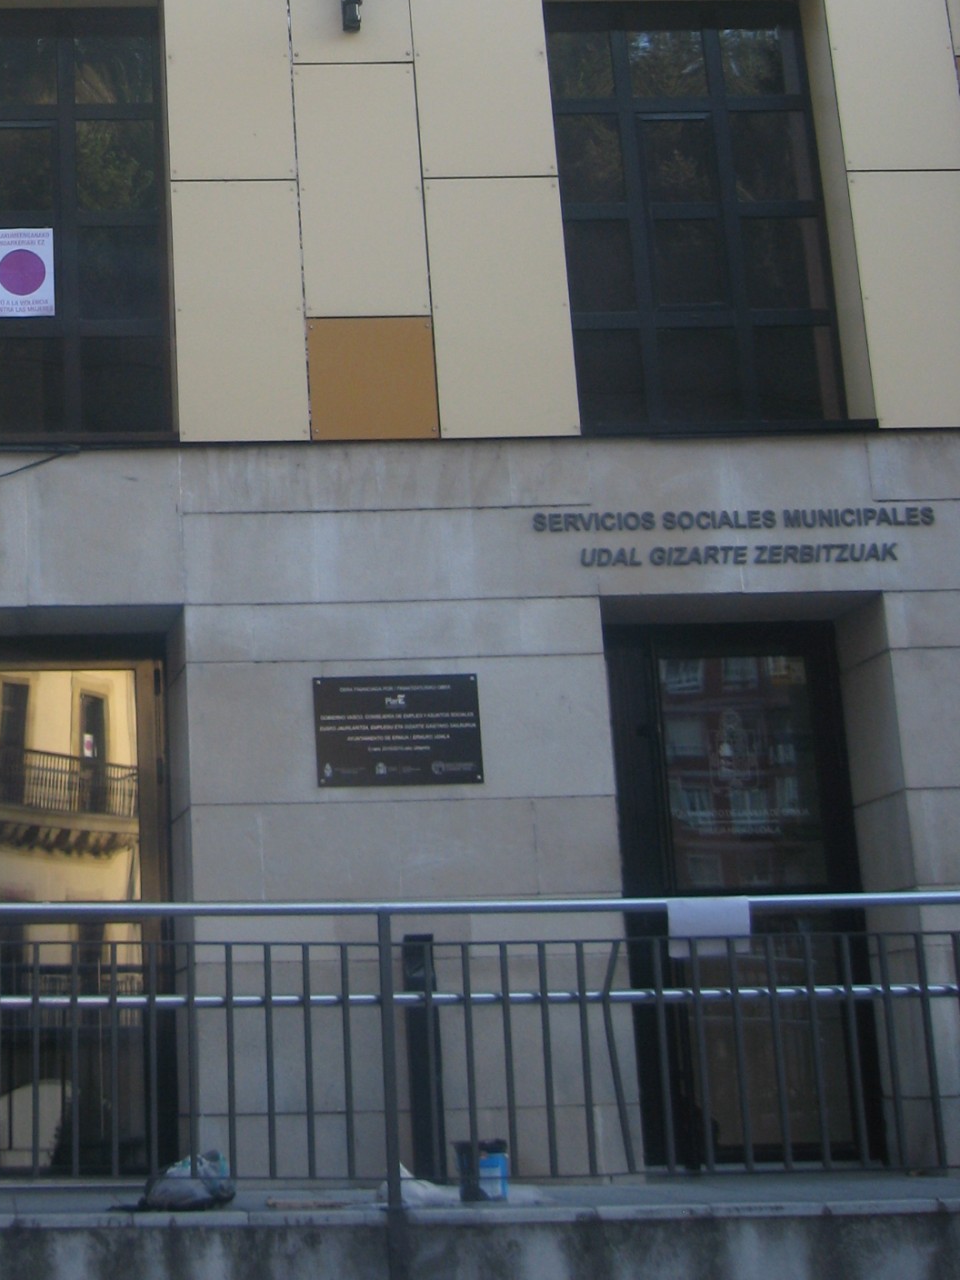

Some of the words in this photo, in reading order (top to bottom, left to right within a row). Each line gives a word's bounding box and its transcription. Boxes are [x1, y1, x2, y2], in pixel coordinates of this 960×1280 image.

[532, 511, 656, 533] SERVICIOS
[662, 509, 777, 531] SOCIALES
[783, 506, 935, 528] MUNICIPALES
[580, 546, 642, 567] UDAL
[649, 545, 748, 567] GIZARTE
[754, 542, 899, 565] ZERBITZUAK
